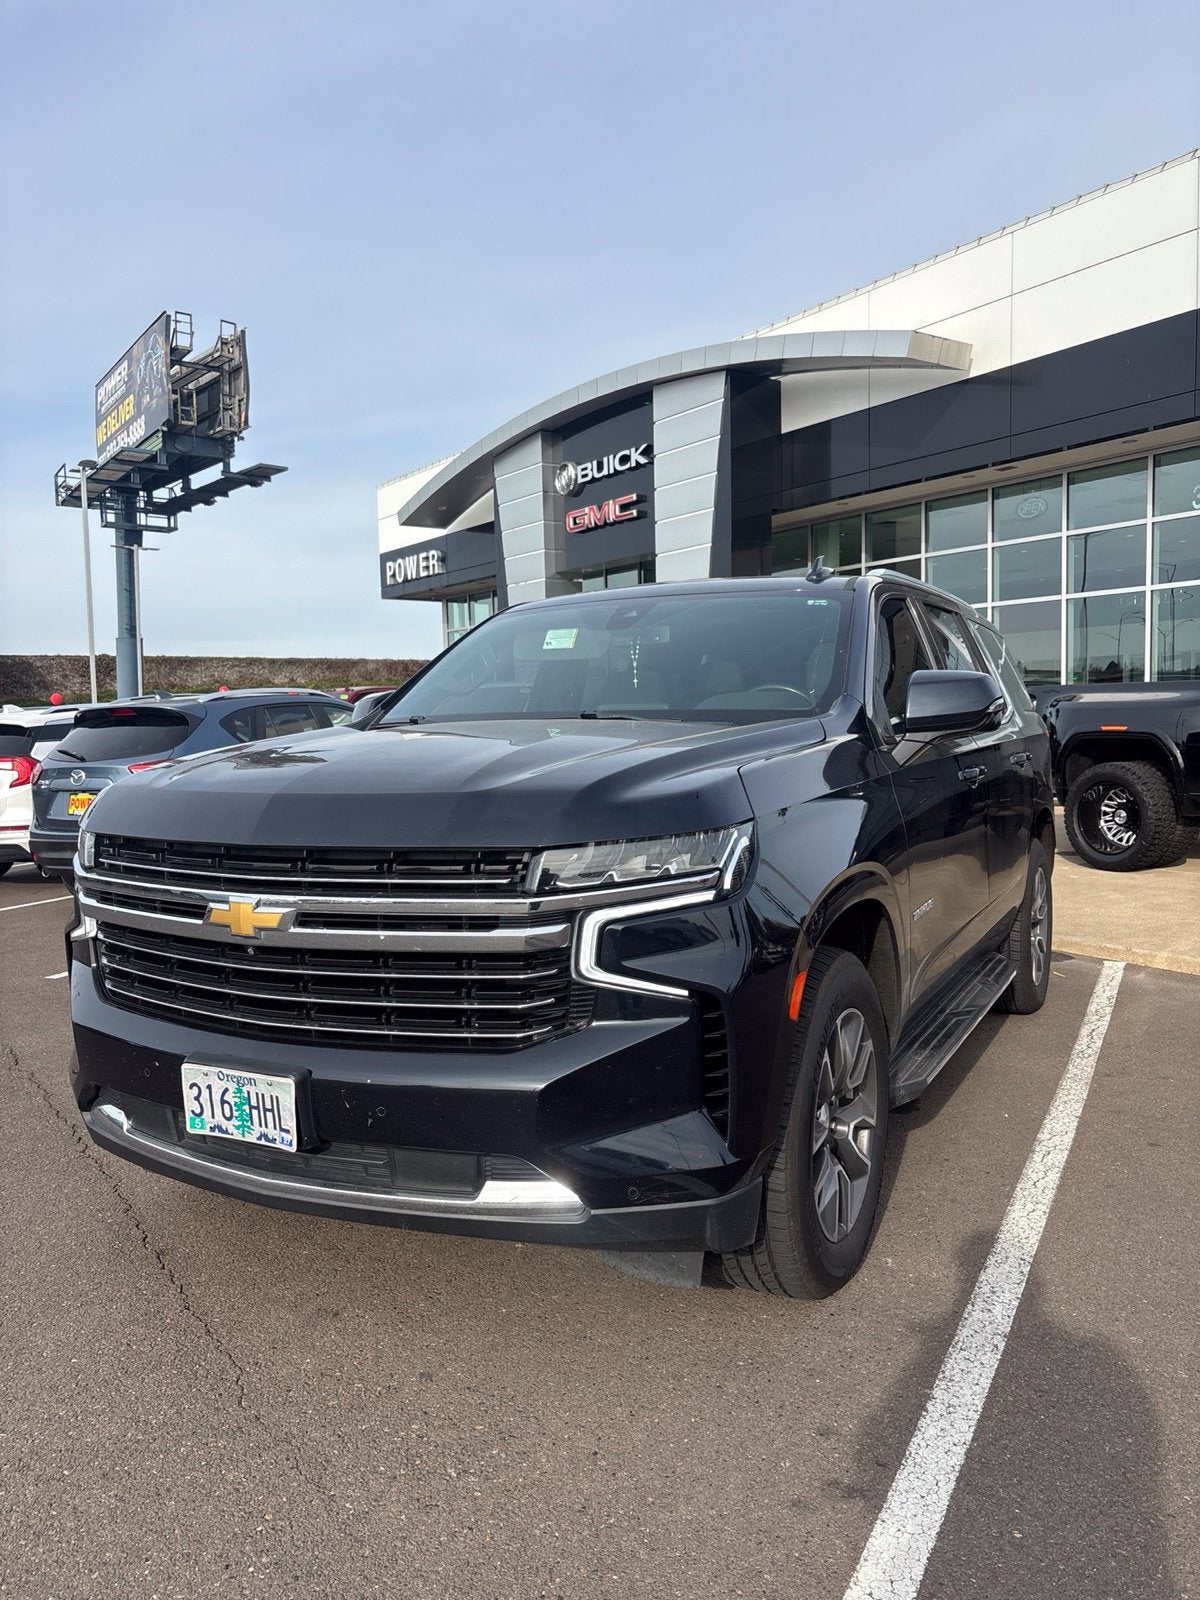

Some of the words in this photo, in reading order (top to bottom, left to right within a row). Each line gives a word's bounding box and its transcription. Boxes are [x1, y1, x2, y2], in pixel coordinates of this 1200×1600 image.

[97, 360, 128, 410] POWER
[96, 420, 107, 447] WE
[106, 394, 134, 437] DELIVER
[577, 443, 649, 484] BUICK
[566, 493, 637, 533] GMC
[1018, 502, 1045, 515] OPEN
[386, 550, 440, 585] POWER
[217, 1070, 257, 1088] Oregon
[189, 1082, 234, 1122] 316
[247, 1090, 291, 1135] HHL
[194, 1119, 202, 1129] 5
